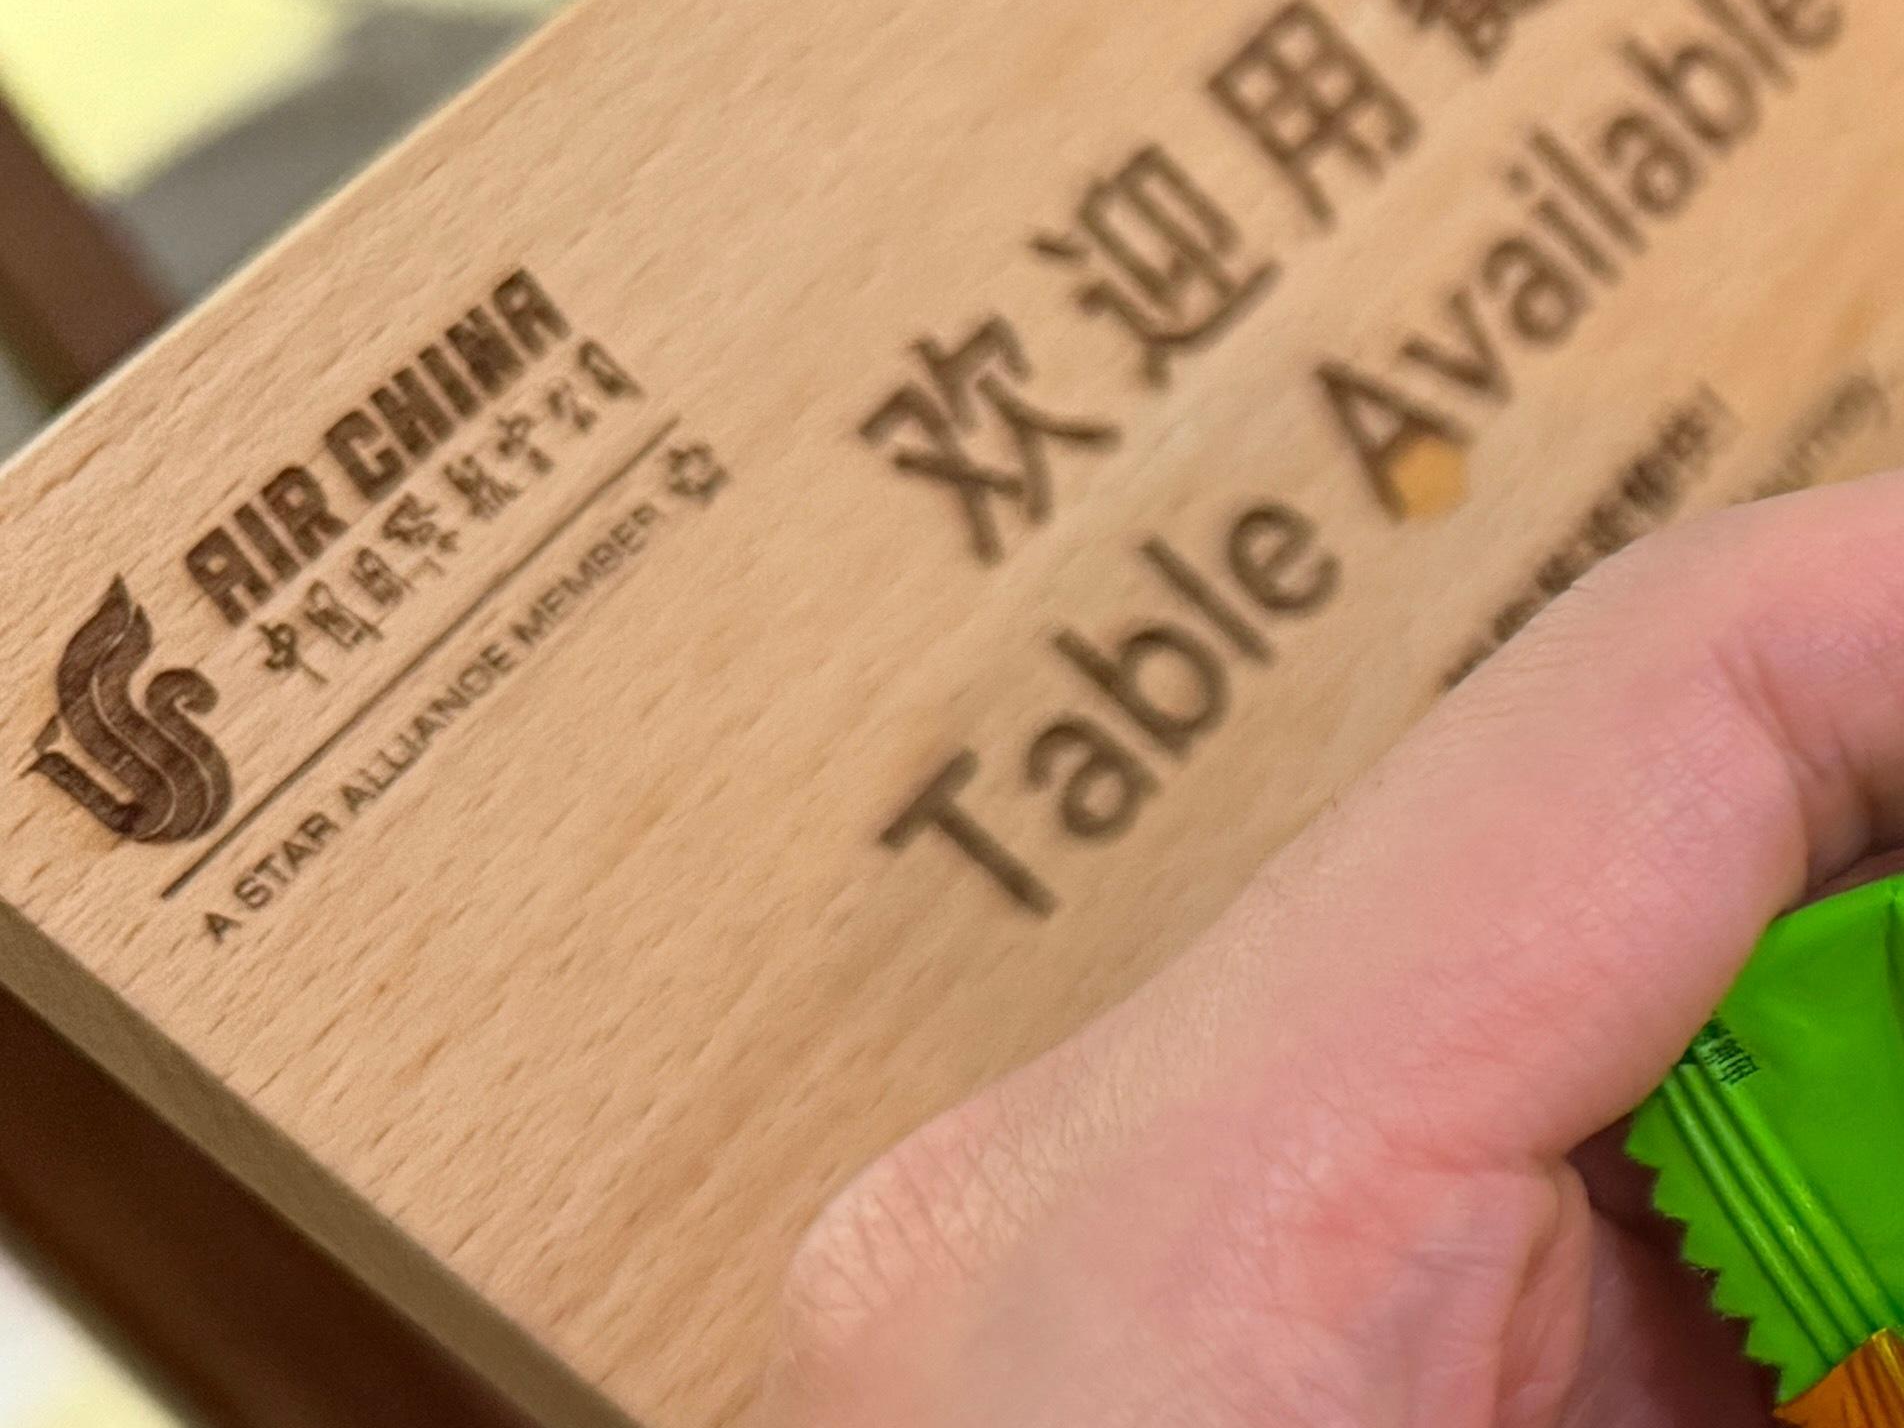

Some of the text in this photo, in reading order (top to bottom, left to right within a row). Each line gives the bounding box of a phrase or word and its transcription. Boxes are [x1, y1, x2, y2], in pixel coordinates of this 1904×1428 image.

[186, 269, 572, 628] AIR CHINA
[203, 502, 664, 945] A STAR ALLIANCE MEMBER
[877, 502, 1341, 920] Table
